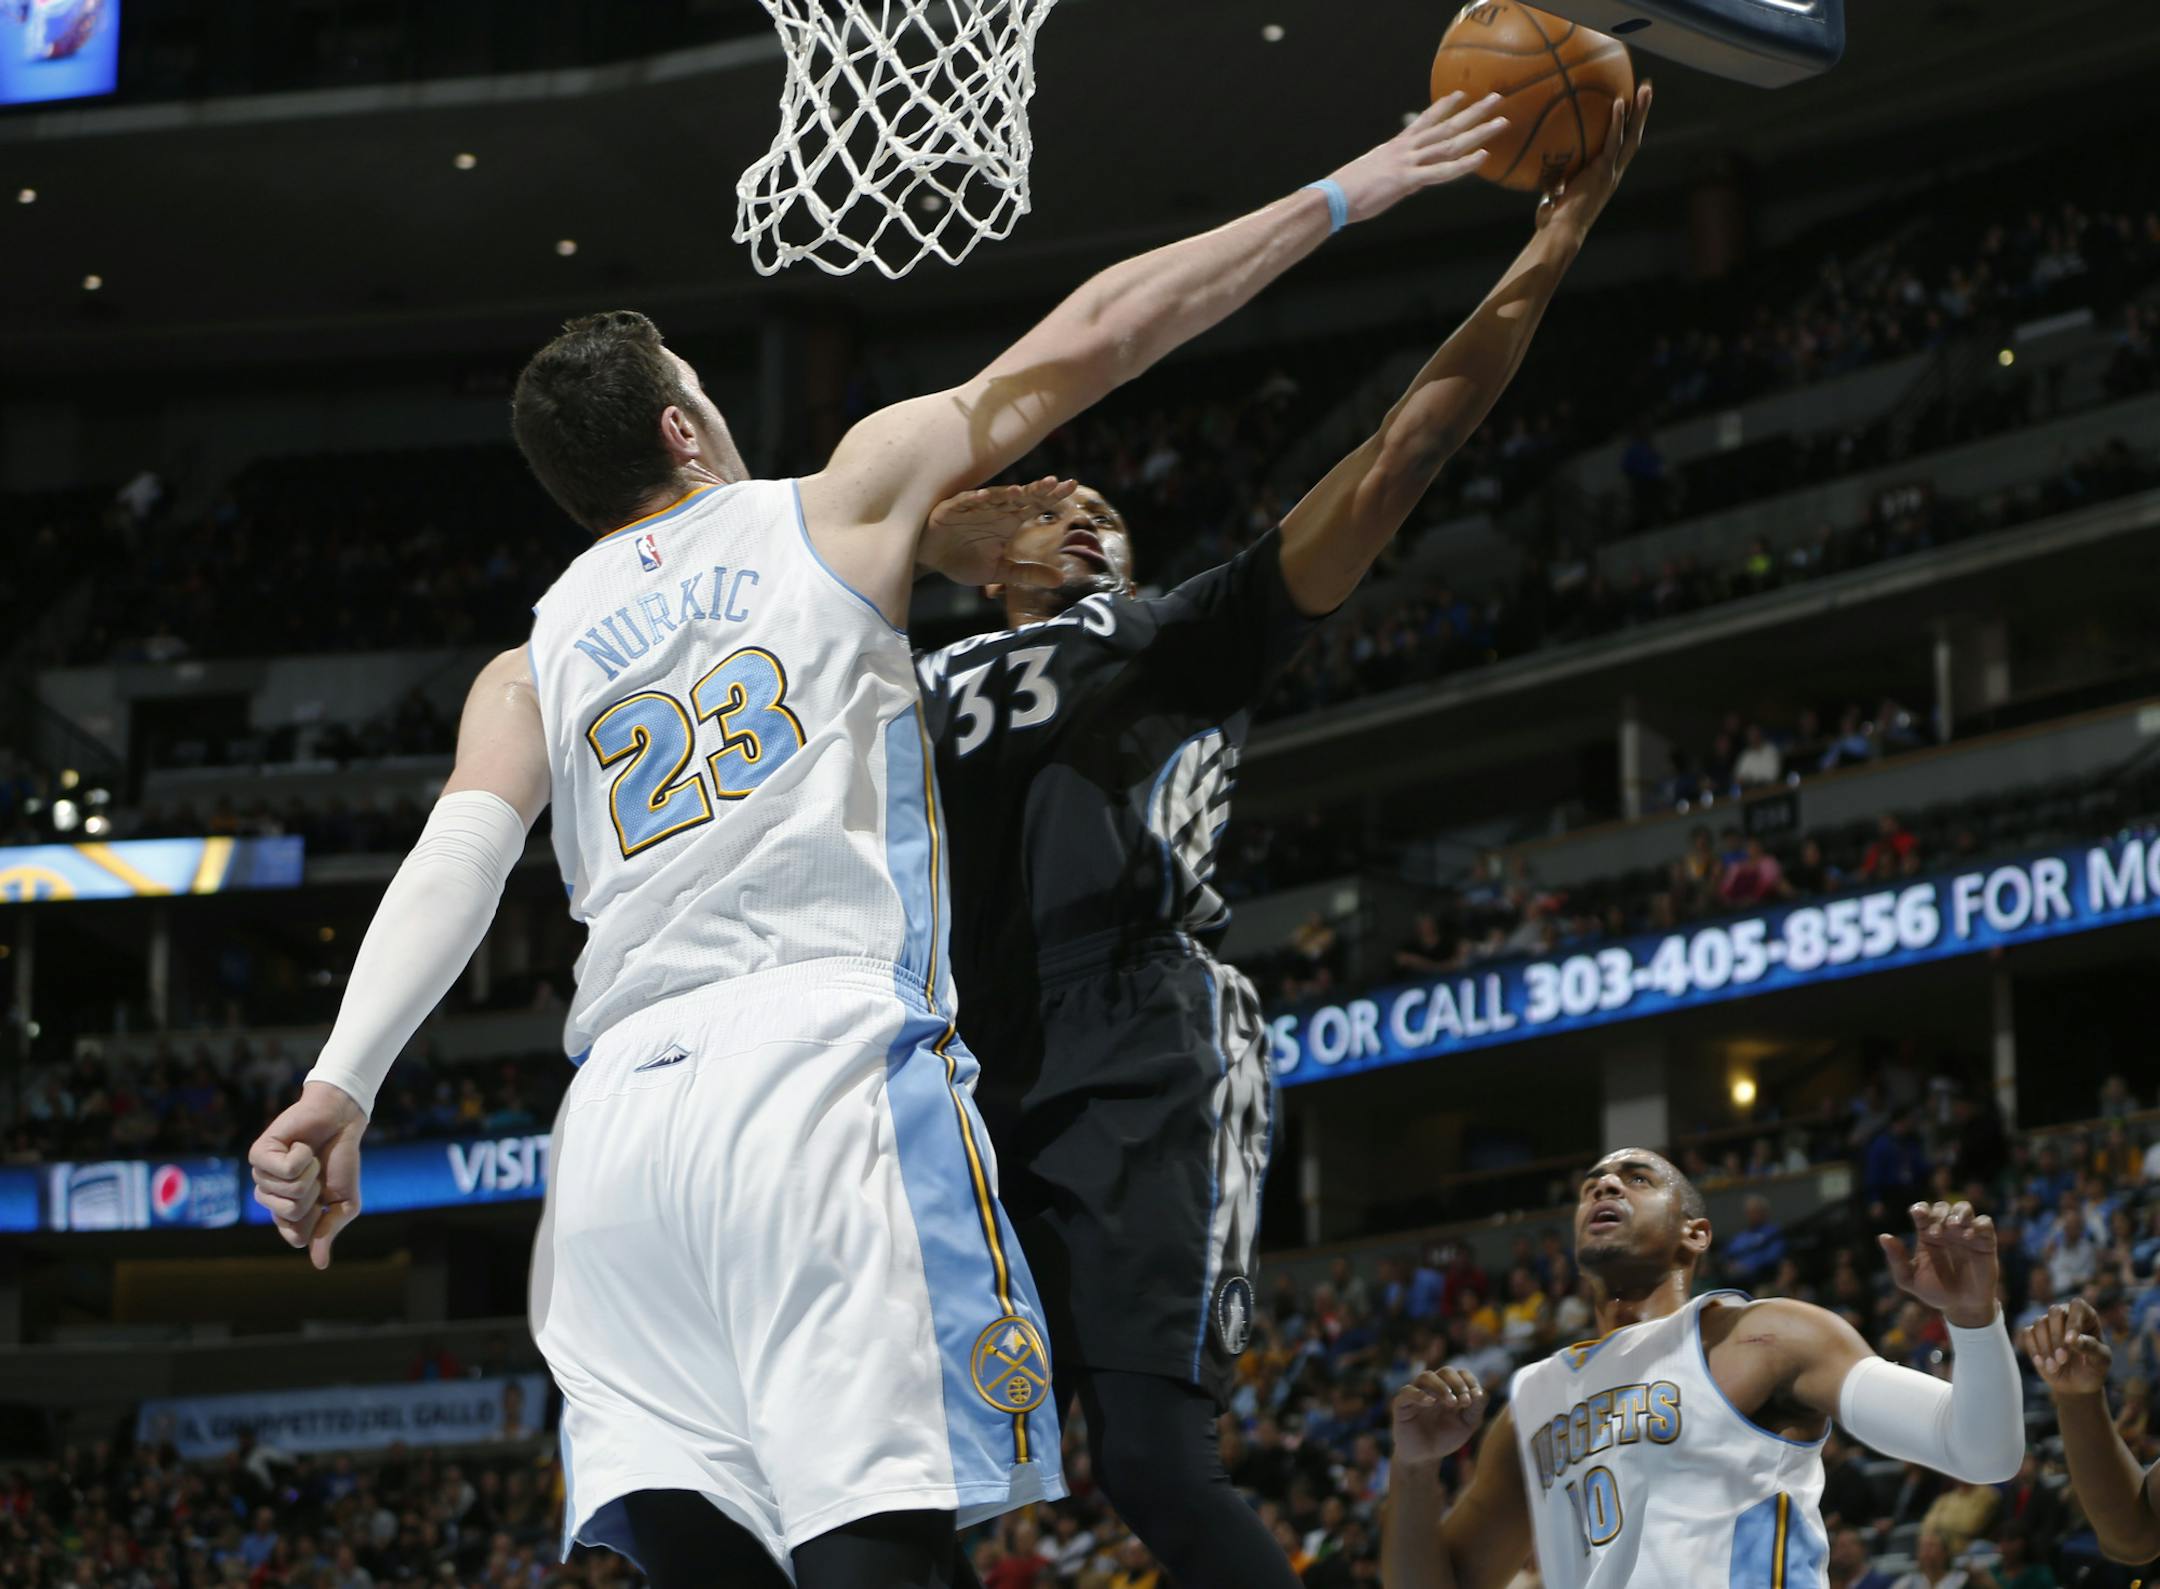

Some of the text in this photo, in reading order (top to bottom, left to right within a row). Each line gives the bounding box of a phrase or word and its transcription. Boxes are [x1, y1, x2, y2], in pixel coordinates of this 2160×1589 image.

[574, 566, 760, 681] NURKIC
[585, 646, 807, 861] 23
[948, 644, 1058, 760] 33
[1309, 999, 1382, 1065] OR
[1391, 972, 1518, 1048] CALL
[1524, 883, 1940, 1024] 303-405-8556
[1952, 857, 2072, 939] FOR
[447, 1134, 551, 1196] VISIT
[1531, 1380, 1681, 1490] UGGETS
[1565, 1466, 1624, 1558] 10
